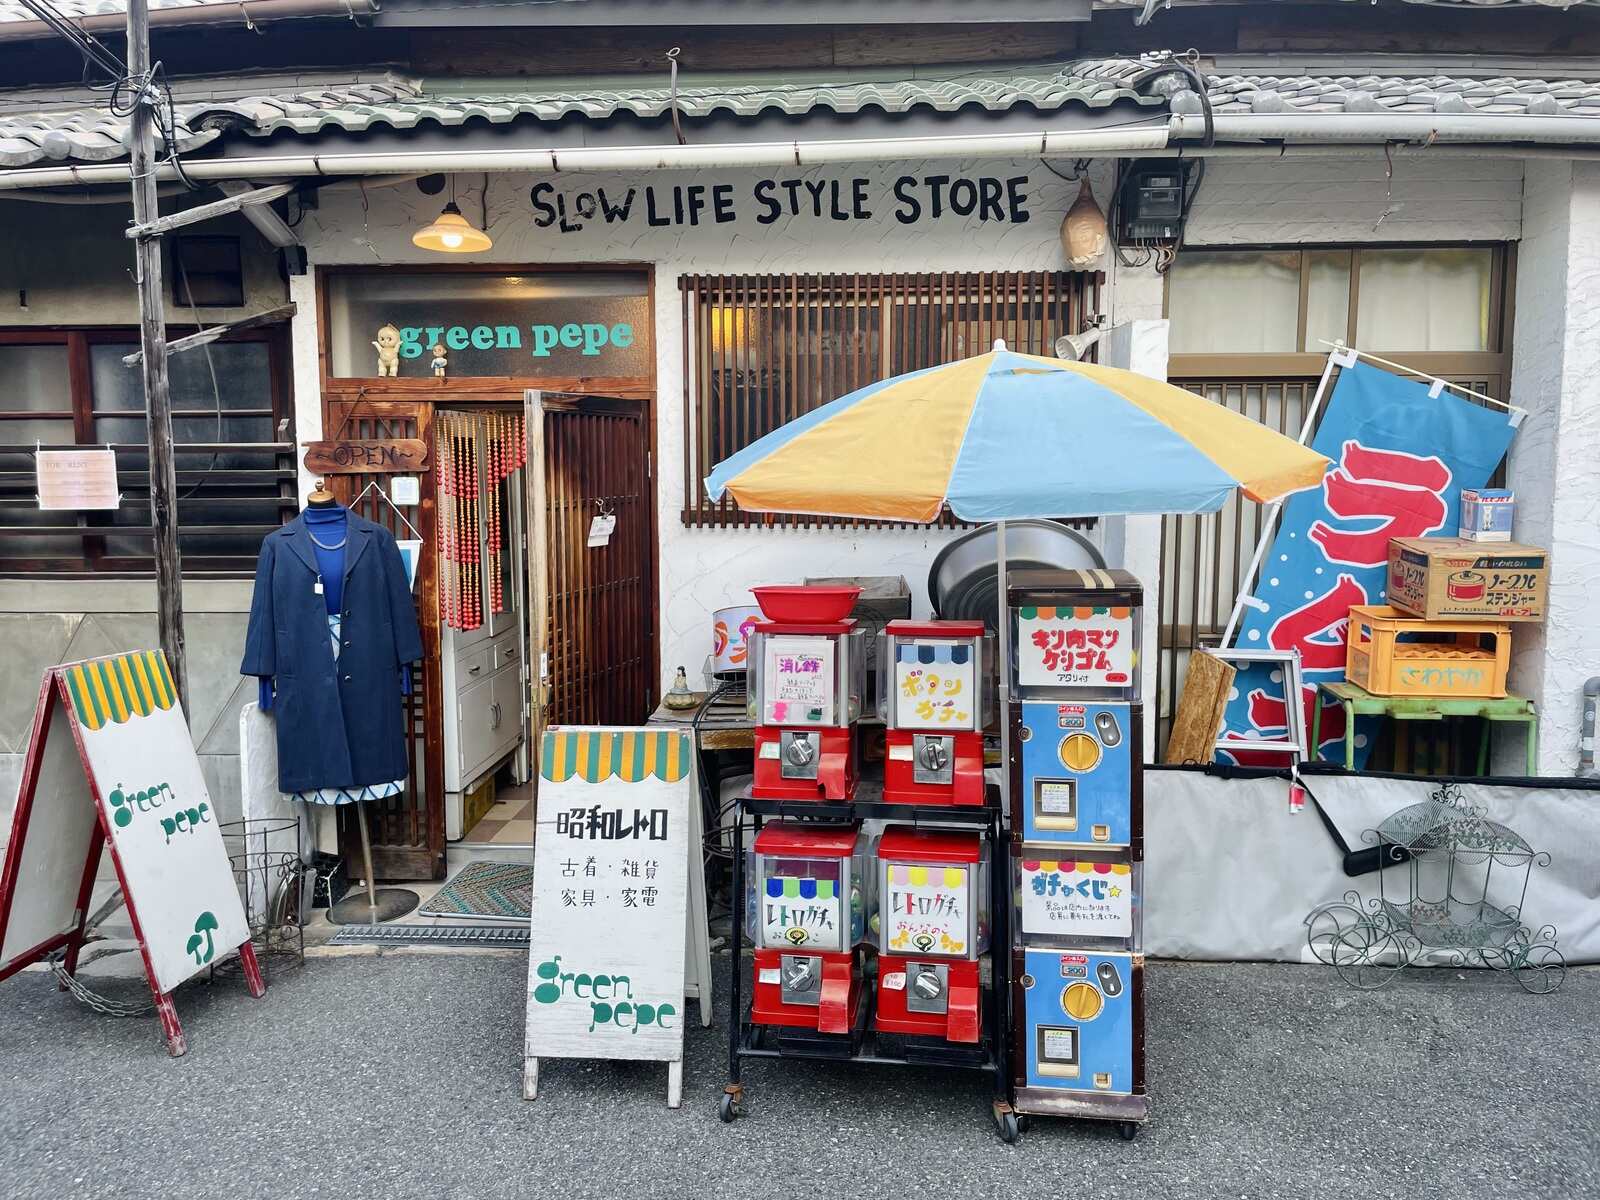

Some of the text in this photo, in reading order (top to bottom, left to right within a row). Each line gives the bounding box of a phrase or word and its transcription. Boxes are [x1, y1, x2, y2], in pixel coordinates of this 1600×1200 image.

[530, 175, 1030, 233] SLOW LIFE STYLE STORE
[399, 322, 634, 359] green pepe
[334, 446, 397, 466] OPEN
[1486, 593, 1536, 606] ステンジャー
[1032, 628, 1120, 650] キン肉マン
[1401, 665, 1484, 688] さわやか
[109, 782, 176, 828] green
[556, 804, 668, 840] 昭和レトロ
[160, 802, 210, 845] pepe
[534, 955, 633, 1004] green
[589, 1001, 676, 1034] pepe
